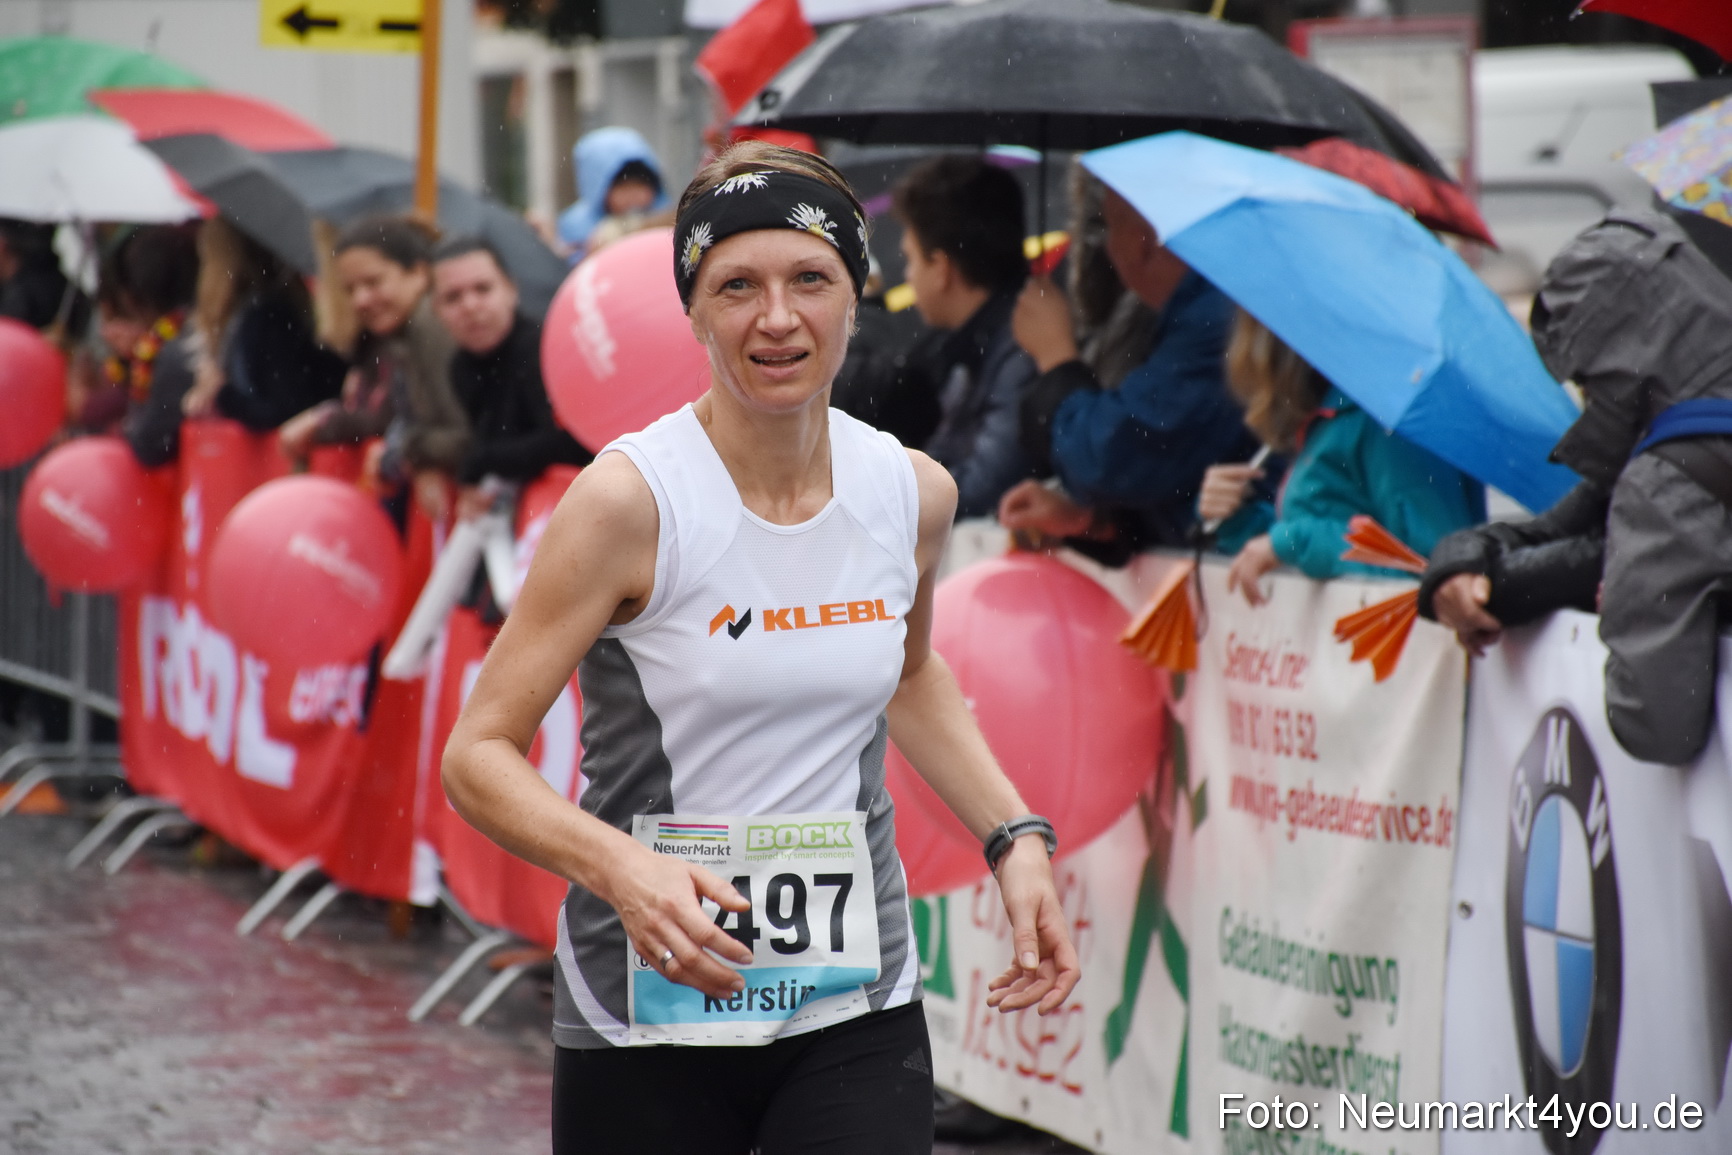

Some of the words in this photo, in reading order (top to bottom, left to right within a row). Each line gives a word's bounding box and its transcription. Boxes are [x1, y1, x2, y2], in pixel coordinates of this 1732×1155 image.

[763, 598, 896, 632] KLEBL
[1510, 714, 1613, 871] BMW
[653, 842, 731, 857] NeuerMarkt
[747, 822, 853, 851] BOCK
[744, 852, 778, 863] inspired
[794, 851, 816, 860] smart
[819, 850, 855, 860] concepts
